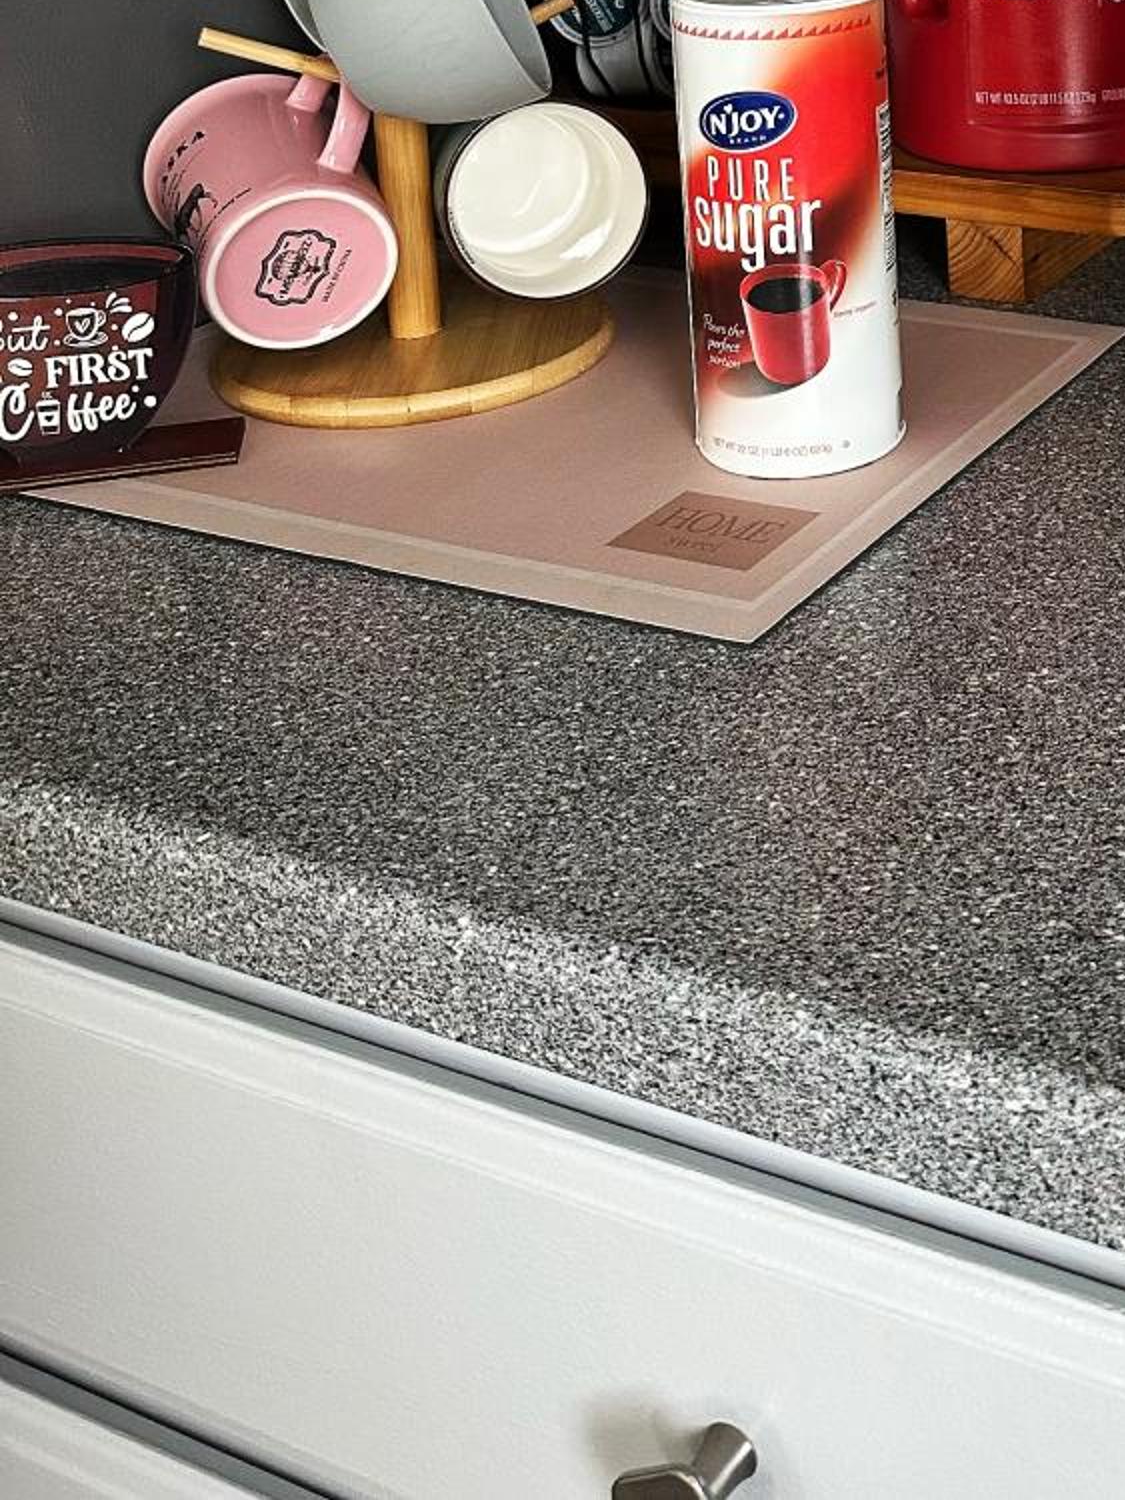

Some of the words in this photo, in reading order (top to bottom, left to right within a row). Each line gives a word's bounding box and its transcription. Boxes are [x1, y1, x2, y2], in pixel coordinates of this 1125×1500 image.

[707, 155, 795, 201] PURE
[695, 196, 822, 273] sugar
[0, 315, 50, 352] ut
[44, 348, 153, 389] FIRST
[656, 506, 786, 544] HOME
